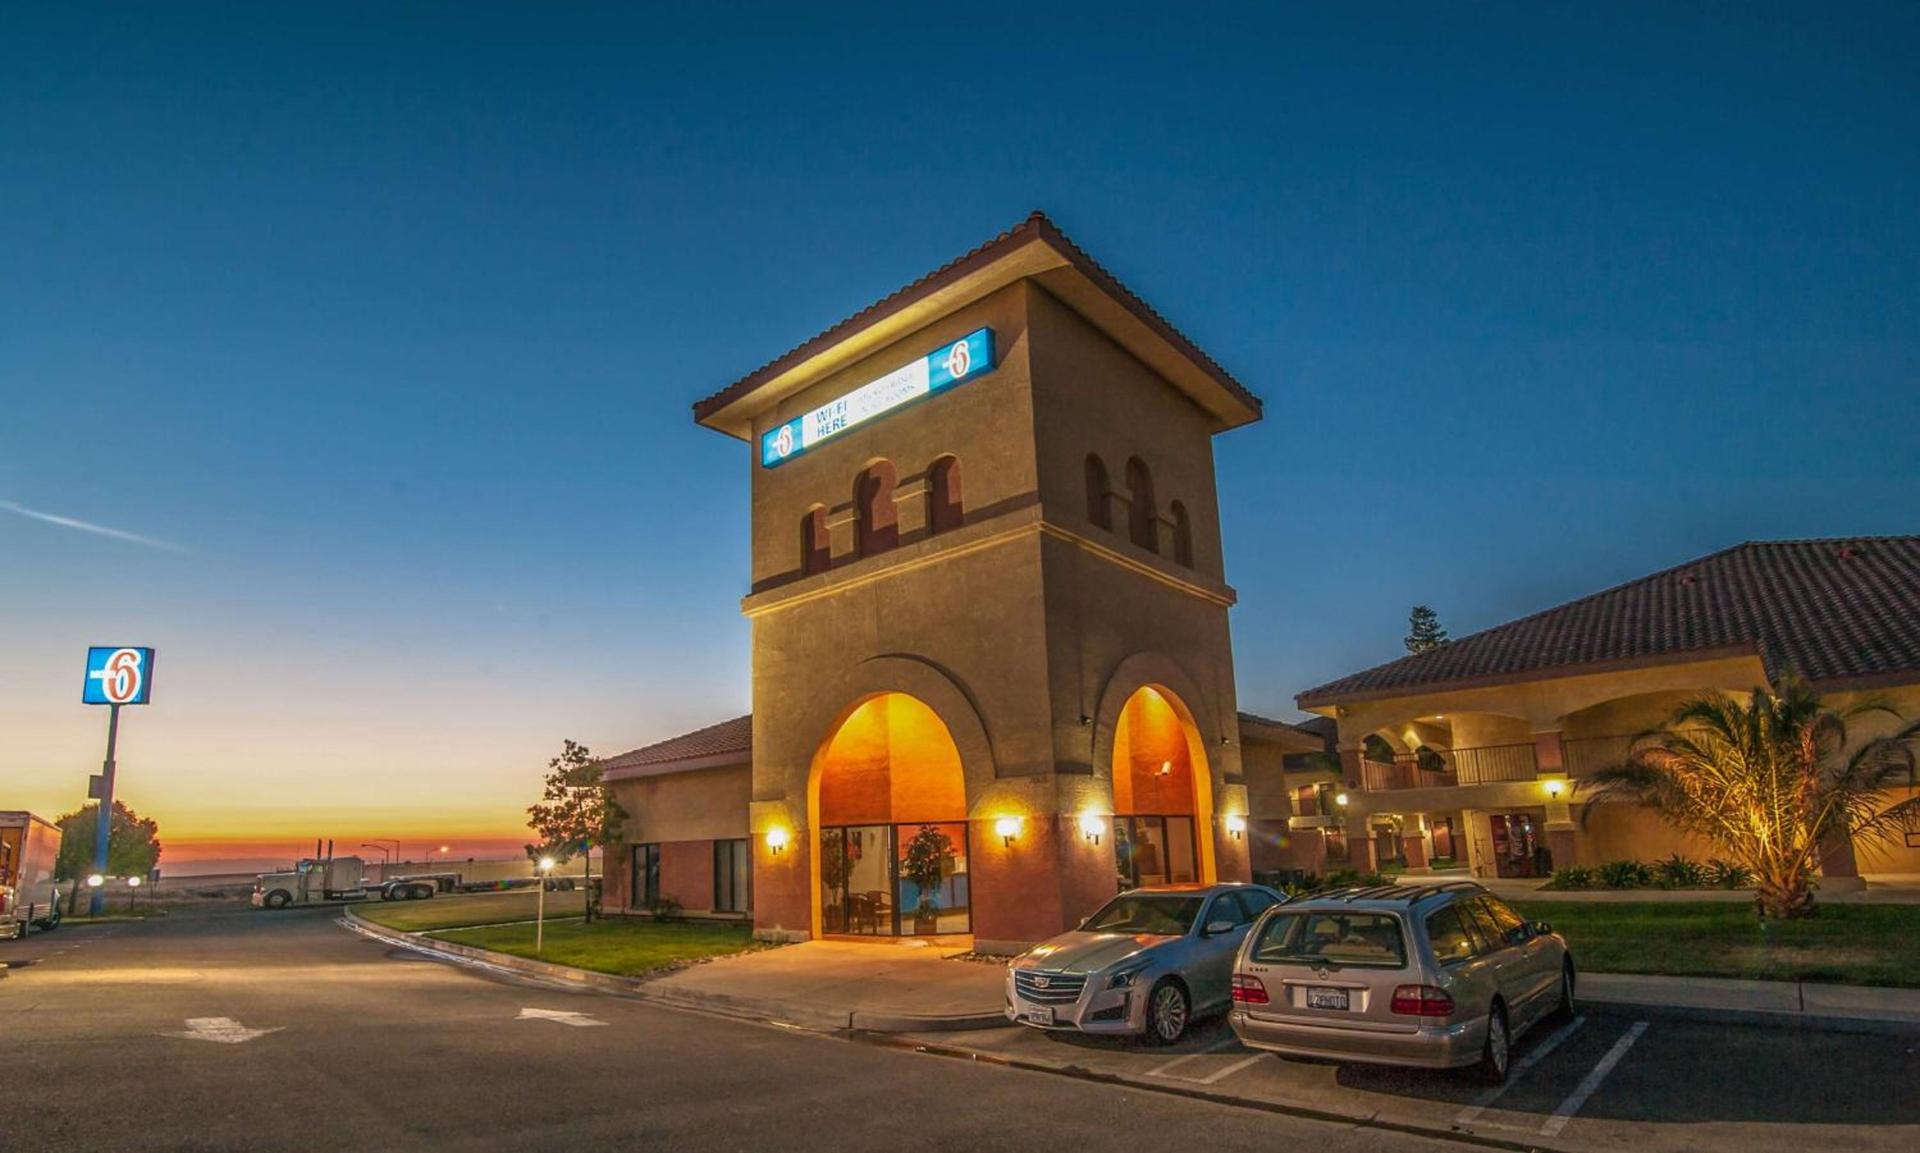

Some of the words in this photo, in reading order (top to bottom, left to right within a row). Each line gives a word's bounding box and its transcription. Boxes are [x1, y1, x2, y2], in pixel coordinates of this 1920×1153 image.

[949, 339, 971, 378] 6
[776, 424, 793, 457] 6
[816, 413, 848, 438] HERE
[102, 648, 142, 703] 6
